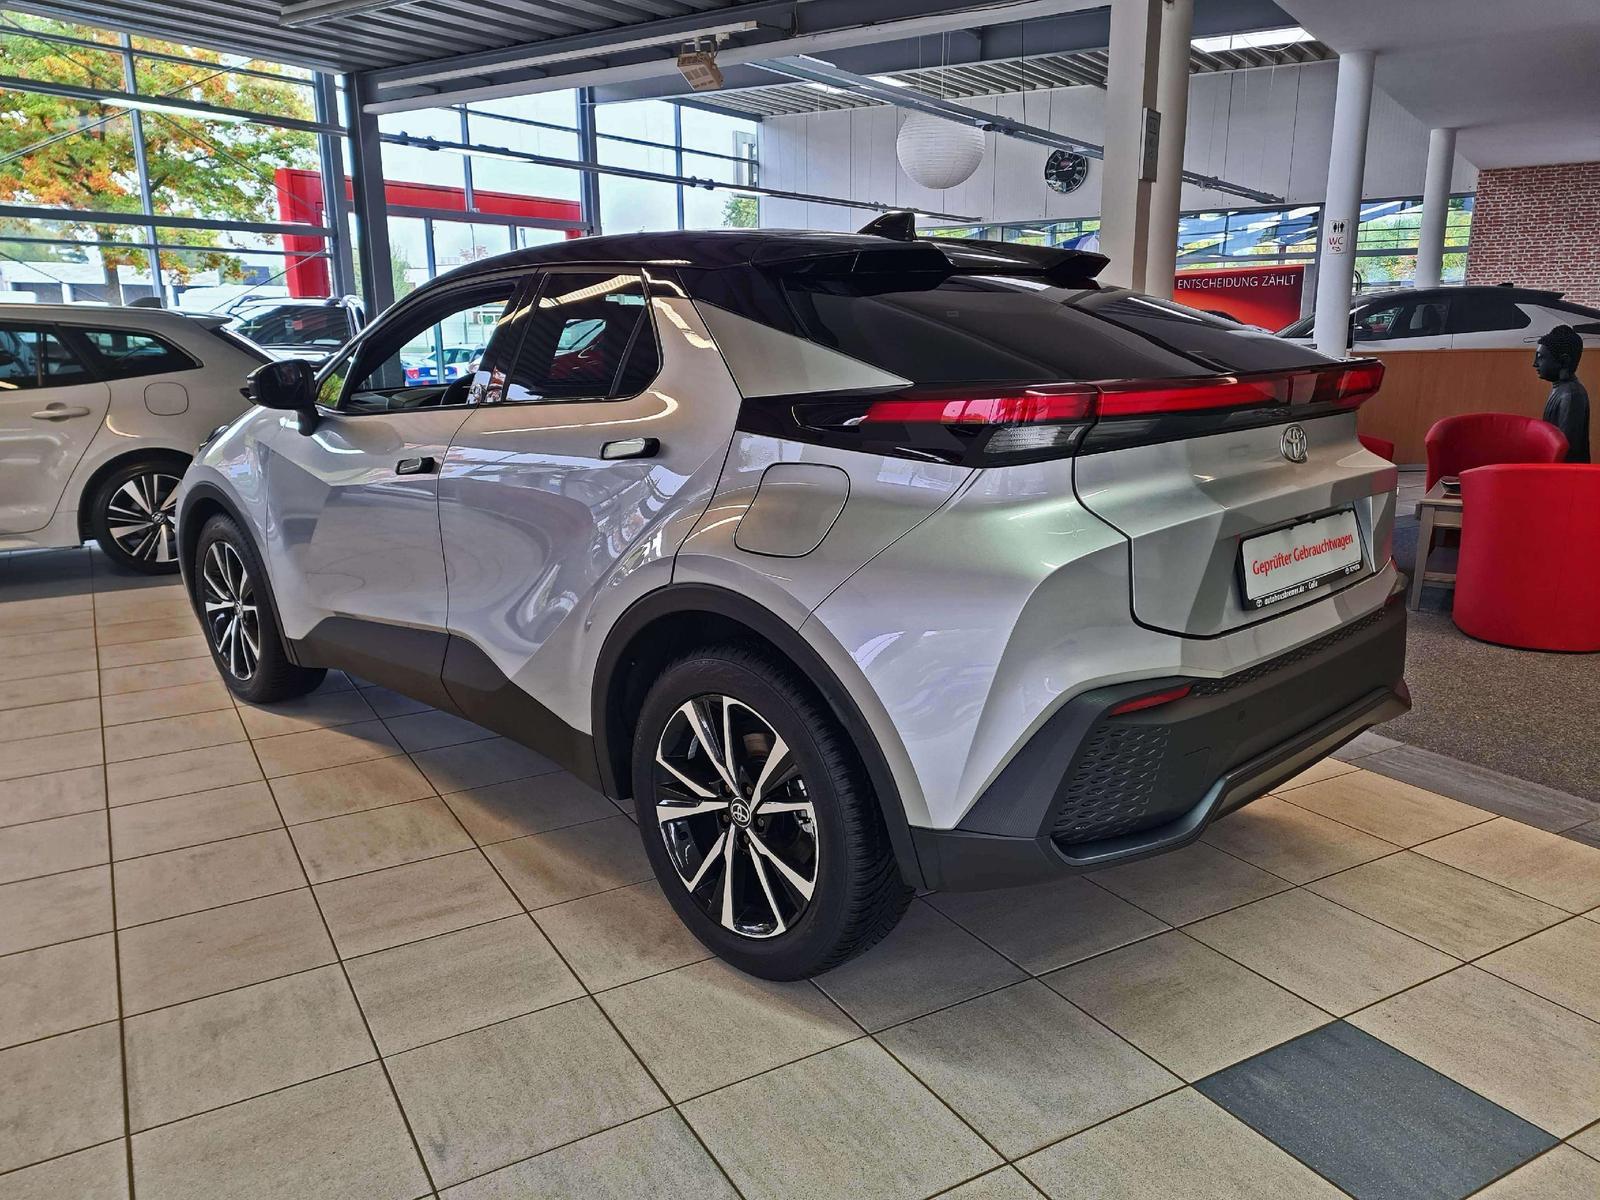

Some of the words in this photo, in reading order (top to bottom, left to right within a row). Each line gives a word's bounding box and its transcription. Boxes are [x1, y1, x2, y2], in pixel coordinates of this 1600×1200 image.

[1329, 236, 1344, 246] WC
[1177, 275, 1259, 290] ENTSCHEIDUNG
[1262, 273, 1296, 287] ZÄHLT
[1252, 552, 1292, 576] Geprüfter
[1293, 533, 1354, 562] Gebrauchtwagen
